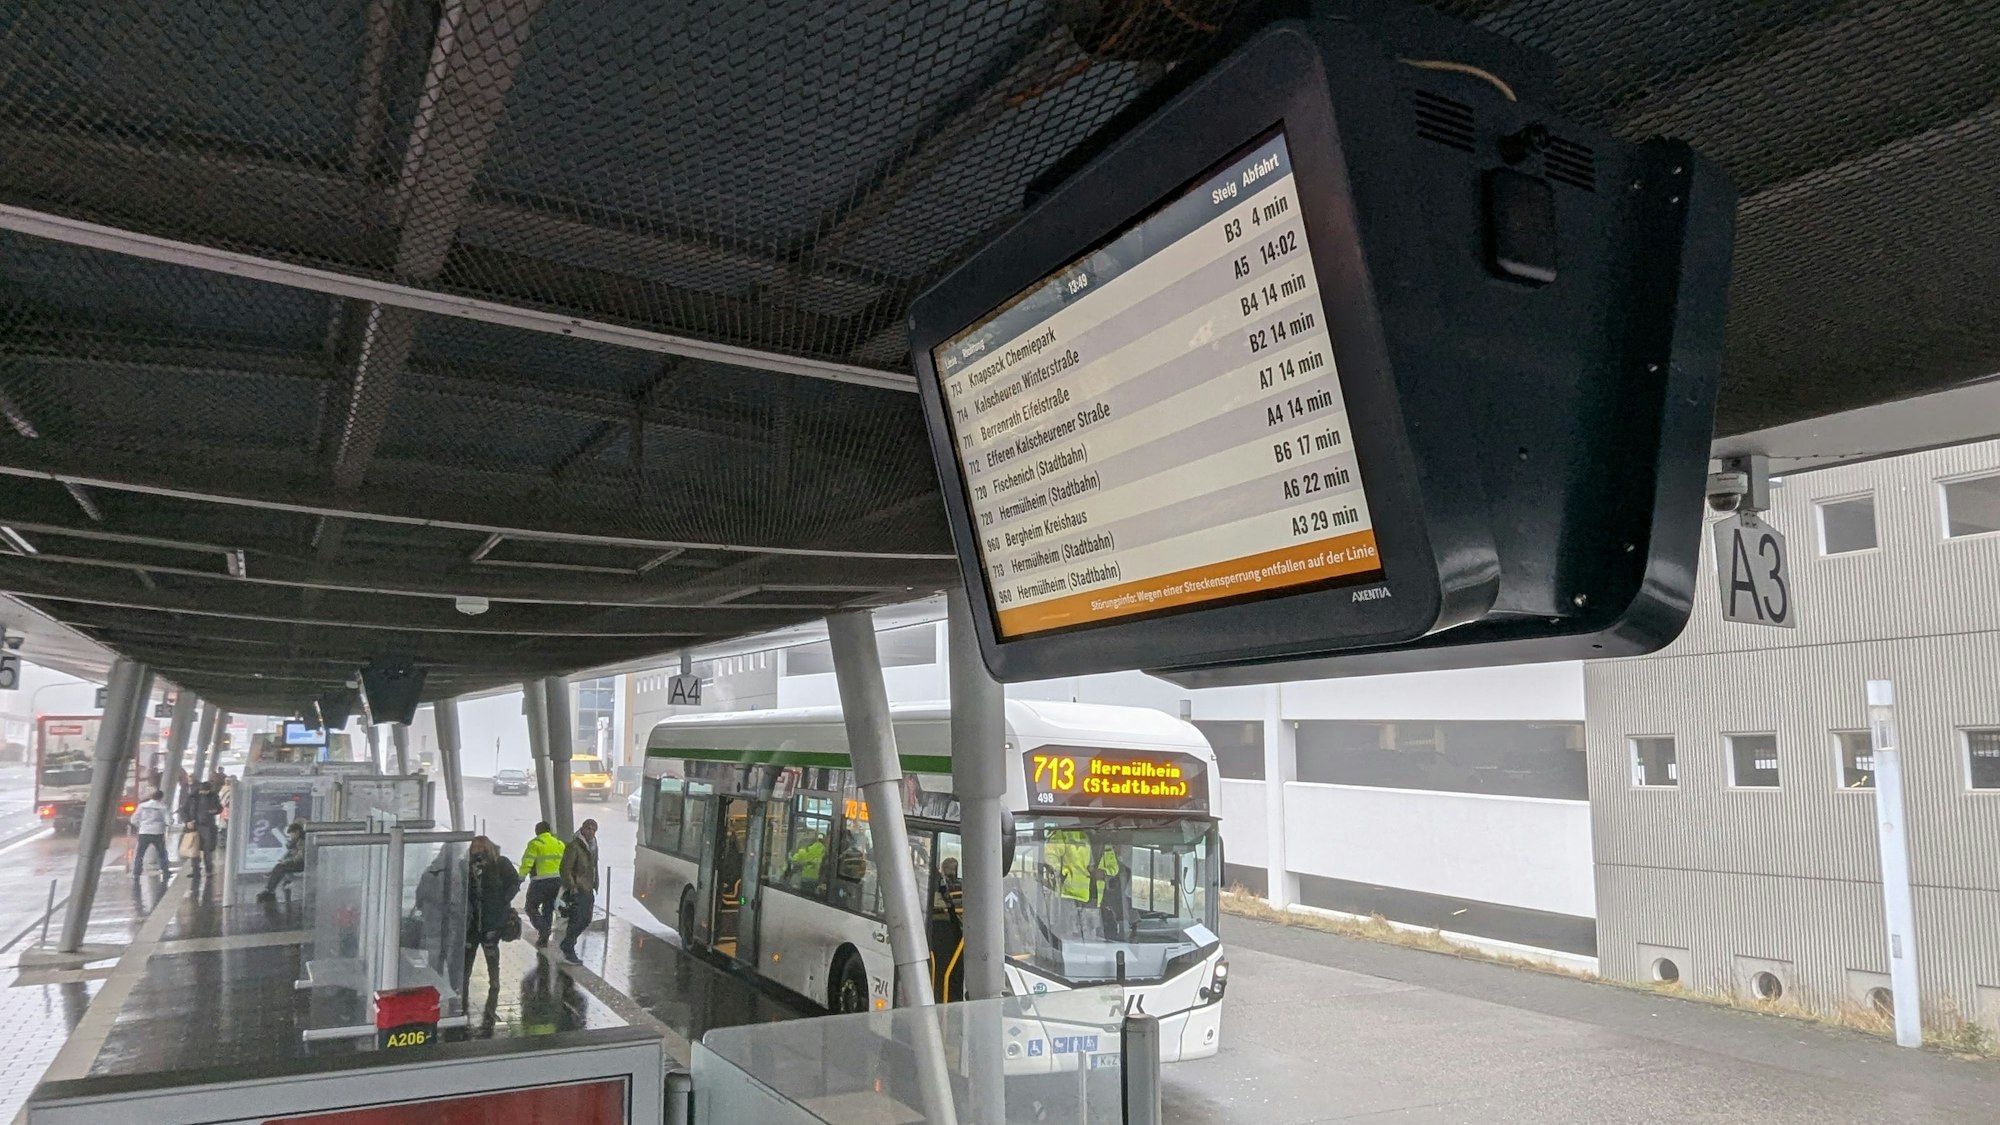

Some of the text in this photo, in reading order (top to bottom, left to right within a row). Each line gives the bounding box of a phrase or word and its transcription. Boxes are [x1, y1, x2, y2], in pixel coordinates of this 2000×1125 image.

[1212, 154, 1280, 204] Steig Abfahrt
[951, 196, 1288, 398] 713 Knapsack Chemiepark B3 4 min
[957, 230, 1298, 424] 714 Kalscheuren Winterstraße A5 14:02
[1068, 273, 1087, 294] 13:49
[963, 273, 1306, 449] 711 Berrenrath Eifelstraße B4 14 min
[969, 312, 1315, 474] 712 Efferen Kalscheurener Straße B2 14 min
[975, 350, 1324, 500] 720 Fischenich (Stadtbahn) A7 14 min
[981, 390, 1332, 526] 720 Hermülheim (Stadtbahn) A4 14 min
[987, 428, 1341, 552] 960 Bergheim Kreishaus B6 17 min
[993, 467, 1350, 578] 713 Hermülheim (Stadtbahn) A6 22 min
[999, 505, 1358, 604] 960 Hermülheim (Stadtbahn) A3 29 min
[1091, 544, 1375, 610] Störungsinfo: Wegen einer Streckensperrung entfallen auf der Linie
[1352, 586, 1391, 602] AXENTIA
[1730, 529, 1787, 623] A3
[670, 678, 700, 704] A4
[1034, 756, 1074, 790] 713
[1038, 793, 1054, 803] 498
[1083, 778, 1186, 796] (Stadtbahn)
[1091, 760, 1180, 778] Hermülheim
